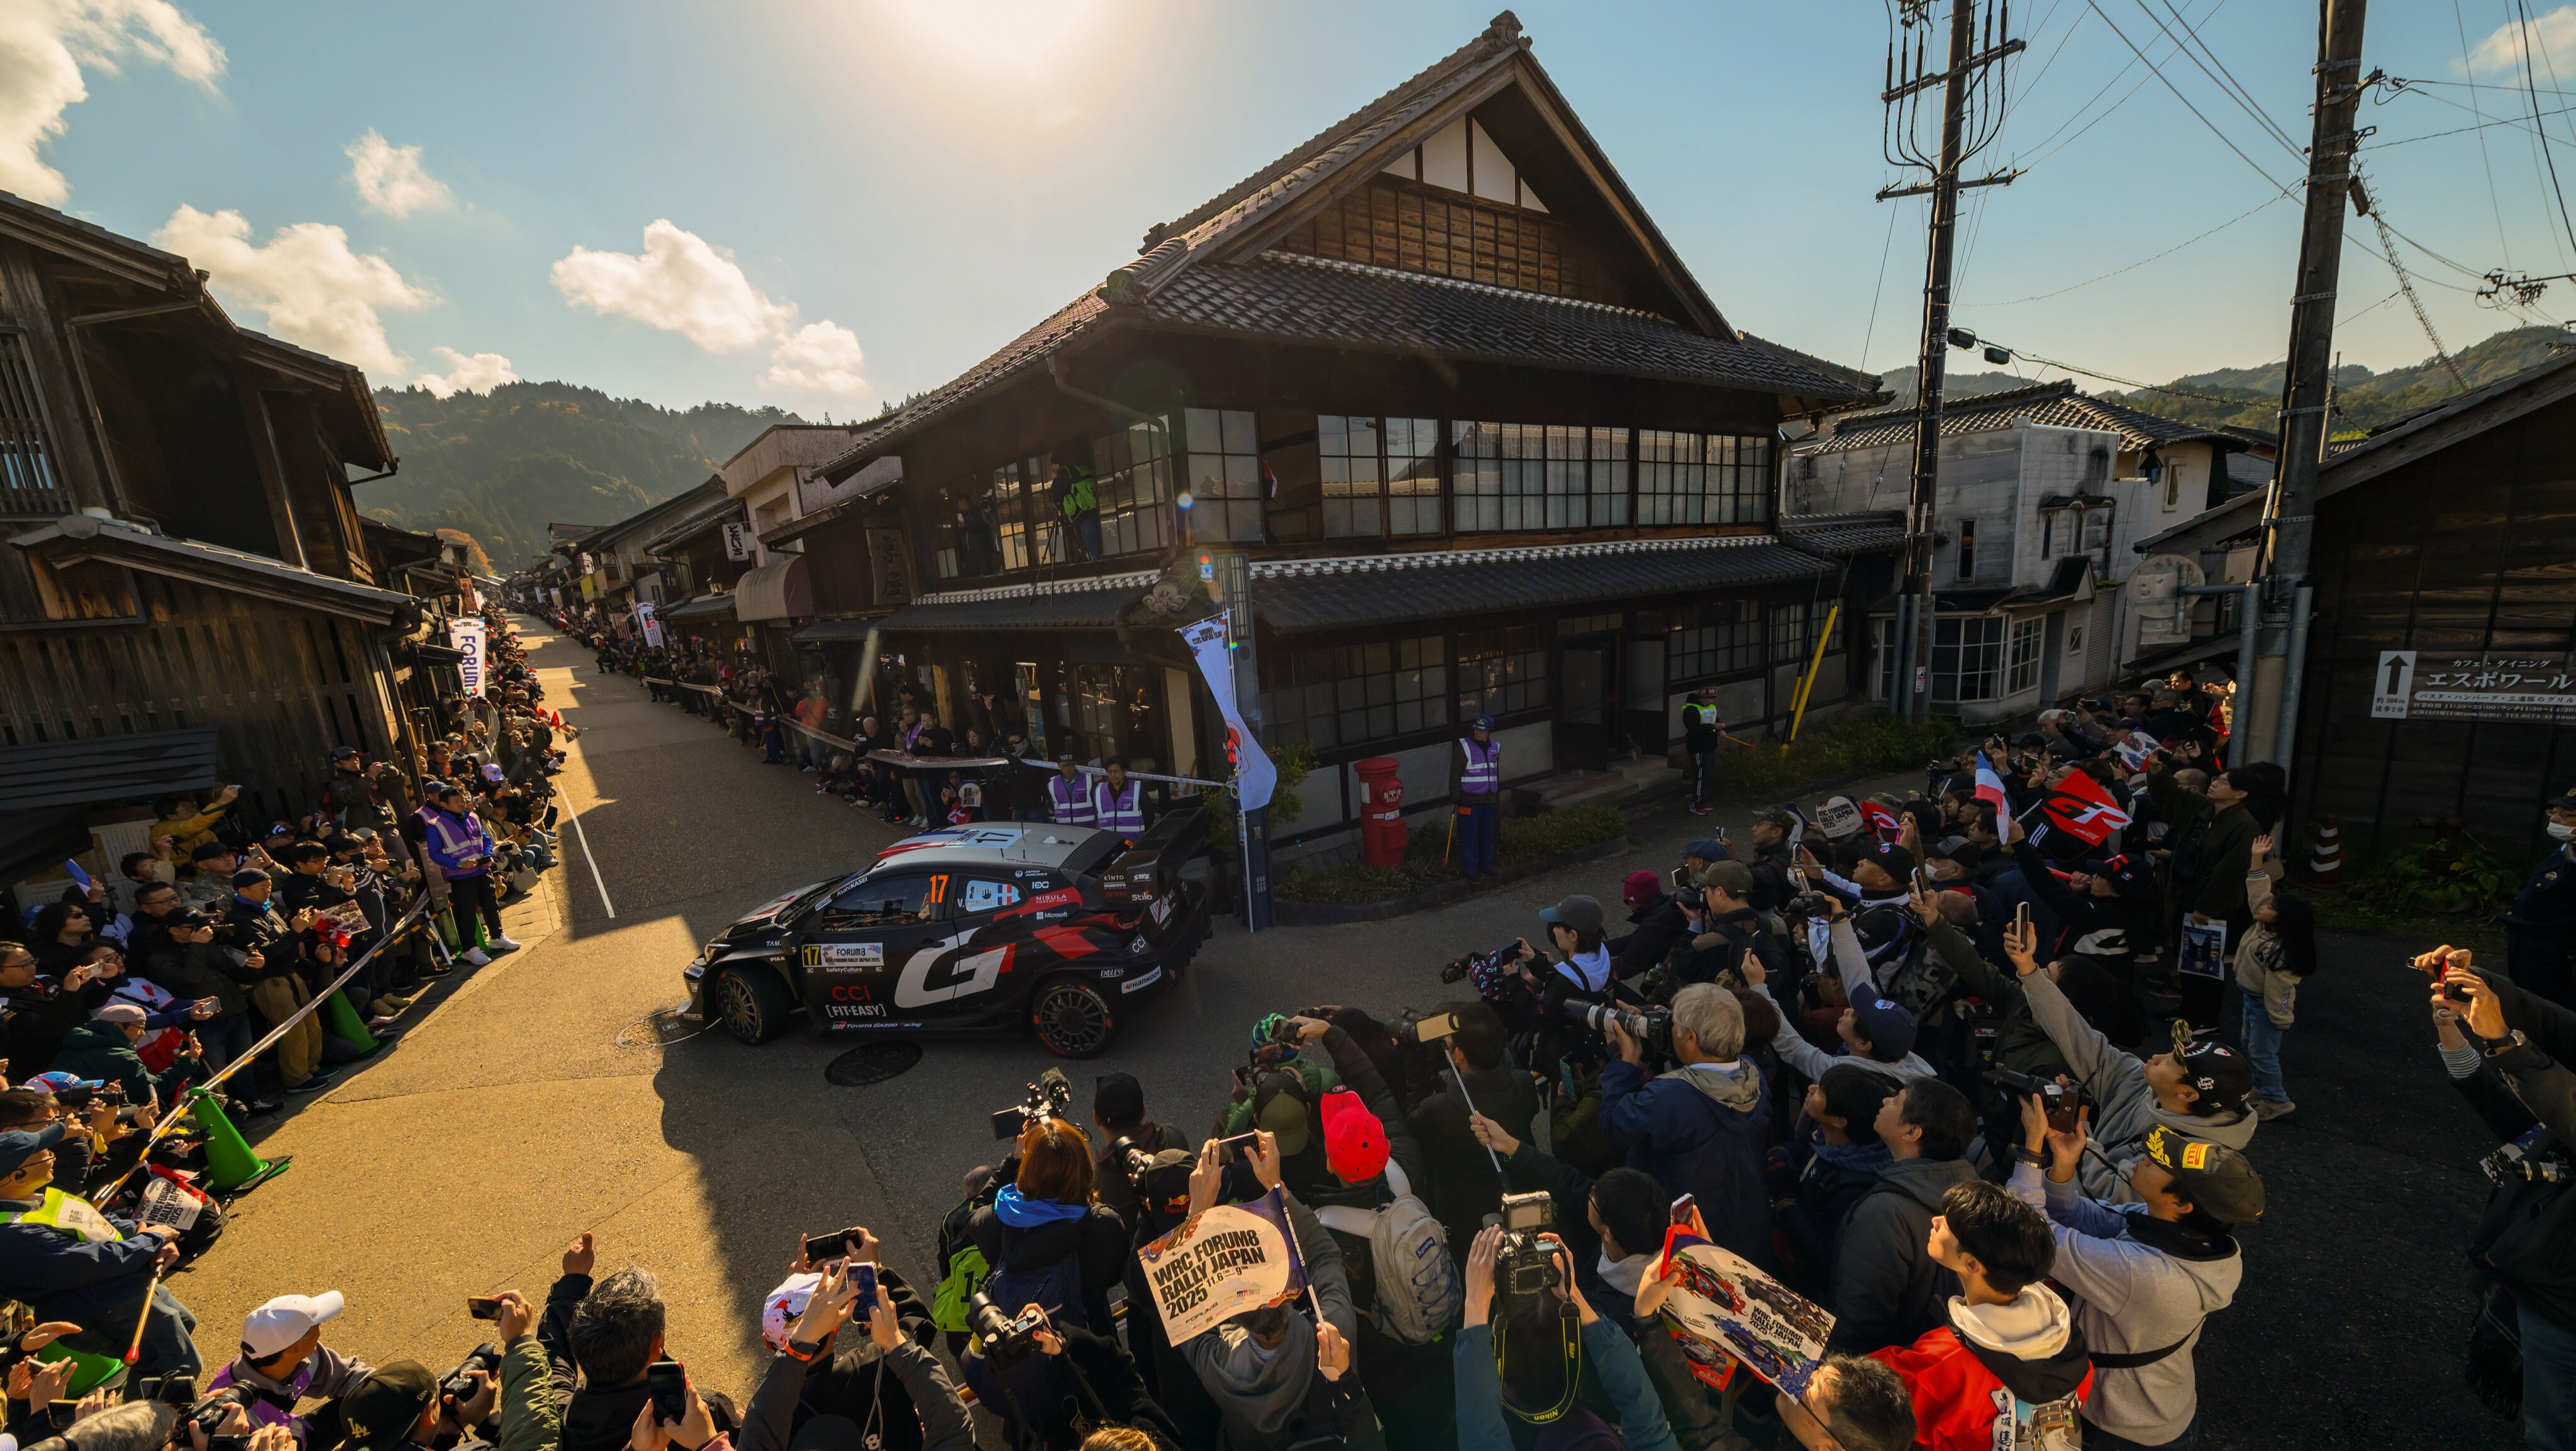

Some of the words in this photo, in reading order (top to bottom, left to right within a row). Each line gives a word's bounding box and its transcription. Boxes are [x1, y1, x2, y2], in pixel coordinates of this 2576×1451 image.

[460, 636, 478, 698] FORUM8
[2452, 659, 2551, 669] カフェ・ダイニング
[2426, 672, 2574, 690] エスポワール
[930, 875, 948, 904] 17
[1132, 890, 1152, 901] Stilo
[957, 898, 965, 908] V.
[804, 946, 820, 965] 17
[836, 948, 866, 956] FORUM8
[1101, 967, 1124, 977] ENDLESS
[147, 1204, 163, 1221] WRC
[156, 1202, 175, 1223] RALLY
[167, 1207, 184, 1225] 2025
[1418, 1239, 1433, 1257] Supreme
[1153, 1252, 1191, 1287] WRC
[1194, 1230, 1260, 1261] FORUM8
[1160, 1261, 1208, 1304] RALLY
[1211, 1247, 1266, 1272] JAPAN
[1166, 1284, 1208, 1320] 2025
[1185, 1302, 1218, 1324] FORUM8
[1685, 1316, 1706, 1327] WRC
[1749, 1318, 1768, 1335] 2025
[1751, 1312, 1774, 1331] RALLY
[1774, 1329, 1801, 1349] JAPAN
[1753, 1305, 1771, 1322] WRC
[1772, 1320, 1804, 1343] FORUM8
[1534, 1409, 1558, 1421] Nikon
[348, 1418, 370, 1438] LA
